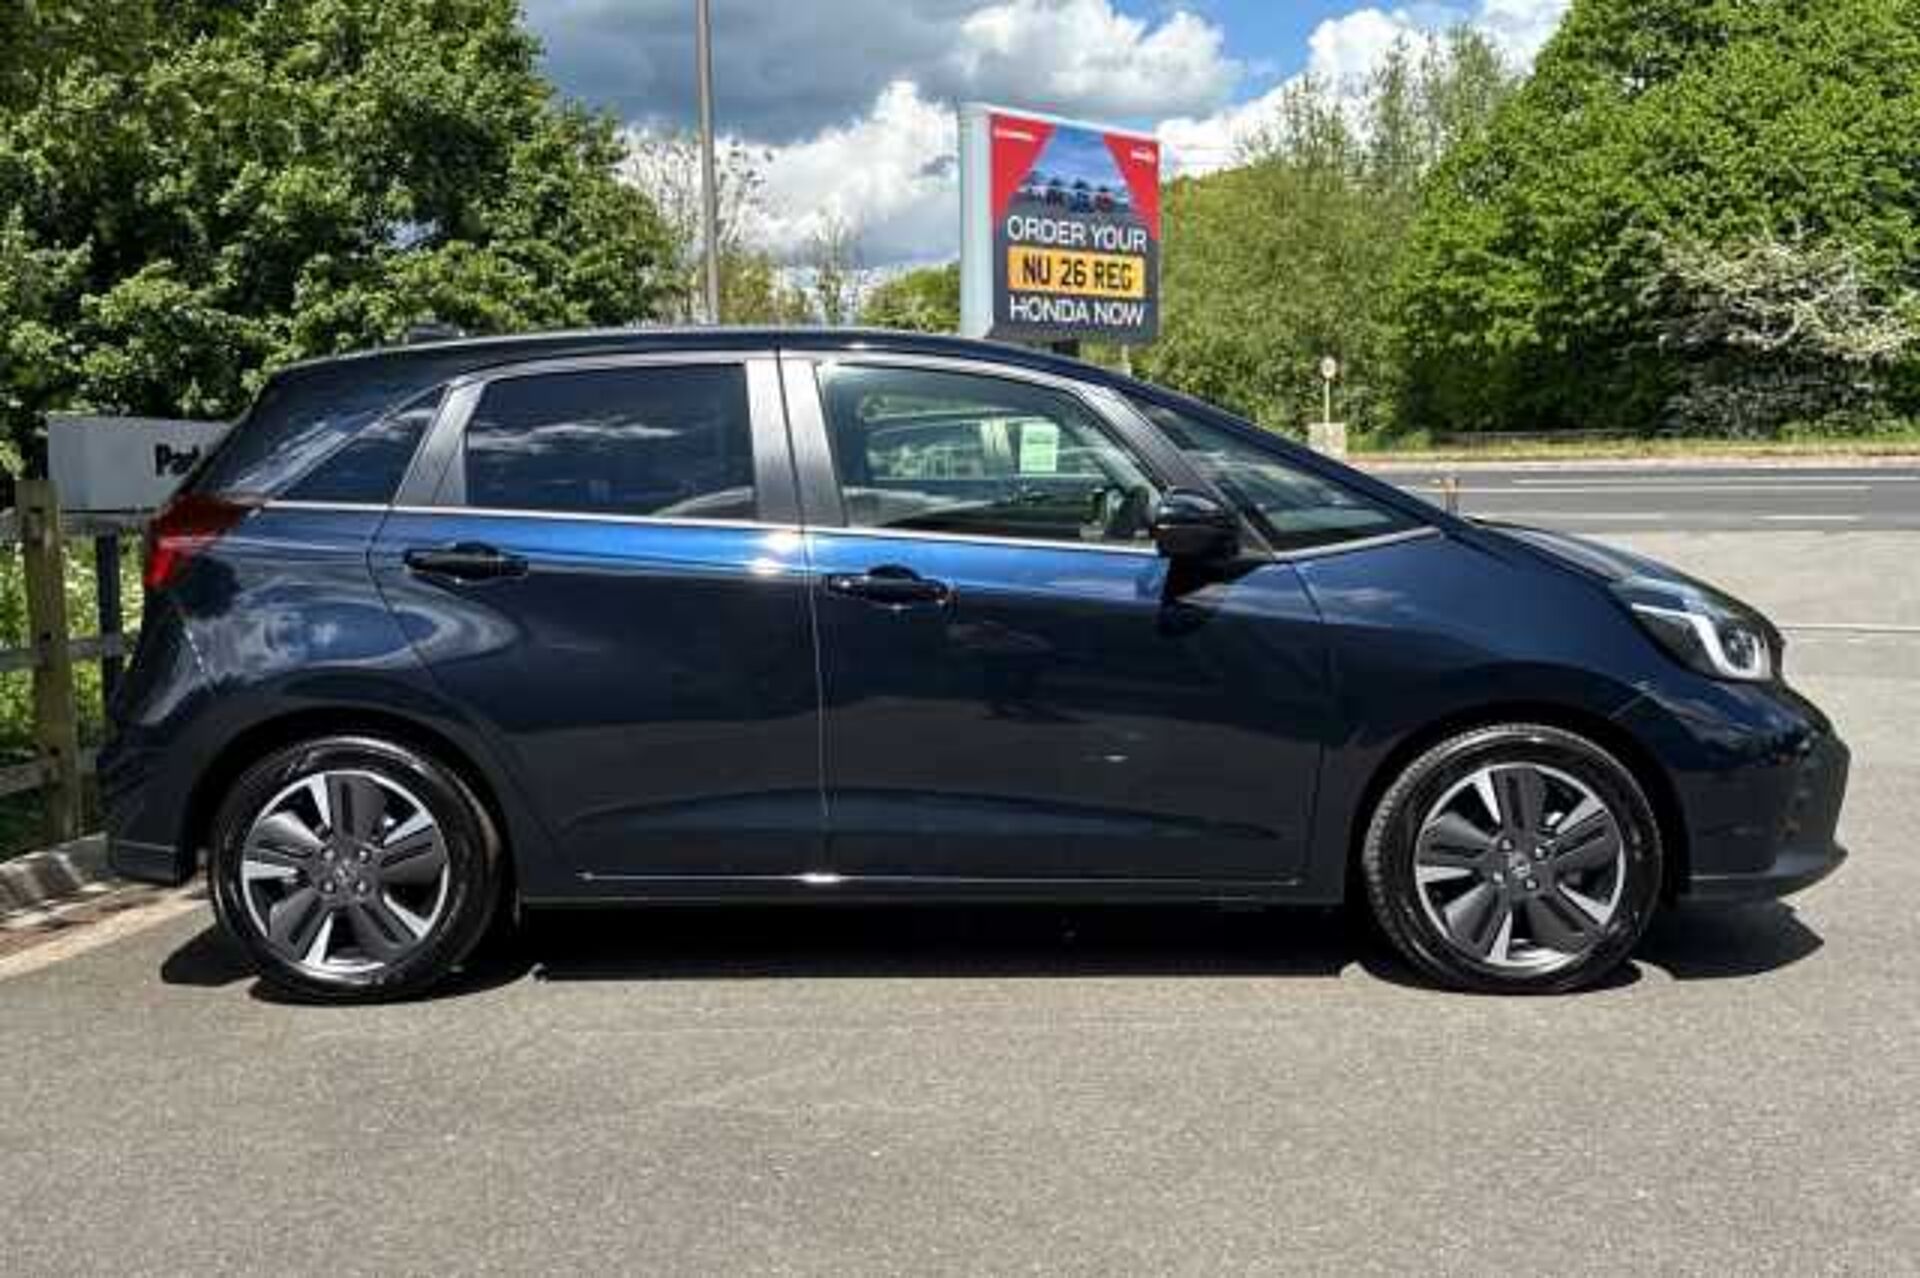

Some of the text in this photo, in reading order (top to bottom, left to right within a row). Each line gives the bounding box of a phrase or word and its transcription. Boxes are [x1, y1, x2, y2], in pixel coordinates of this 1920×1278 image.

[1007, 215, 1147, 252] ORDER YOUR
[1022, 254, 1132, 291] NU 26 REG
[1009, 295, 1145, 326] HONDA NOW
